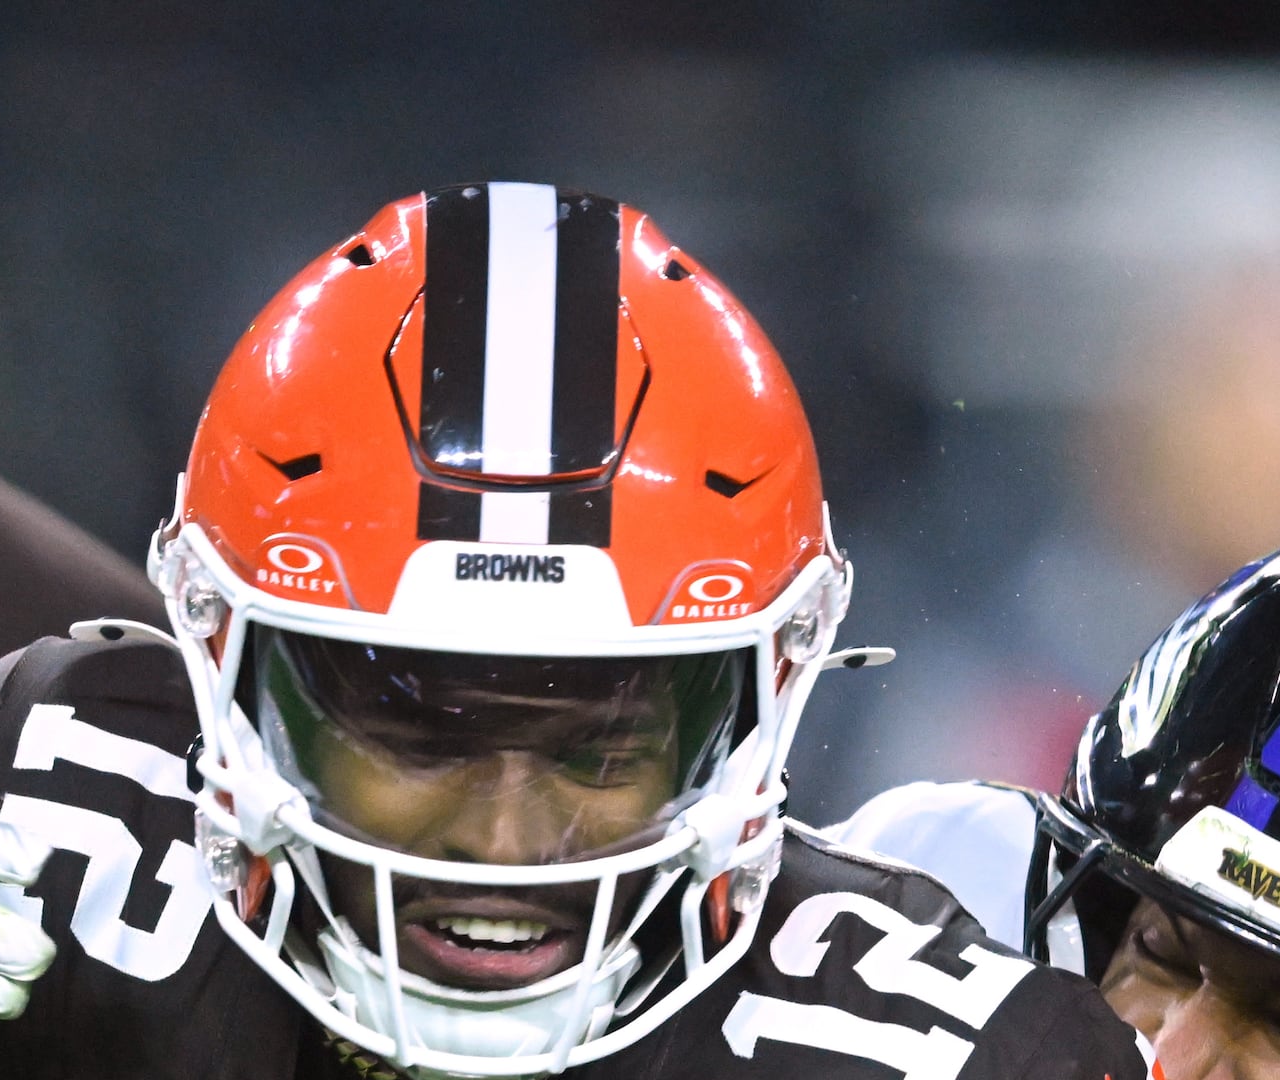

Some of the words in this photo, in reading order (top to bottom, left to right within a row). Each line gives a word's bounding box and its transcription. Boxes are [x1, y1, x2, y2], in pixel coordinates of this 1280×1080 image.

[257, 568, 336, 593] OAKLEY
[456, 553, 565, 583] BROWNS
[671, 602, 753, 618] OAKLEY
